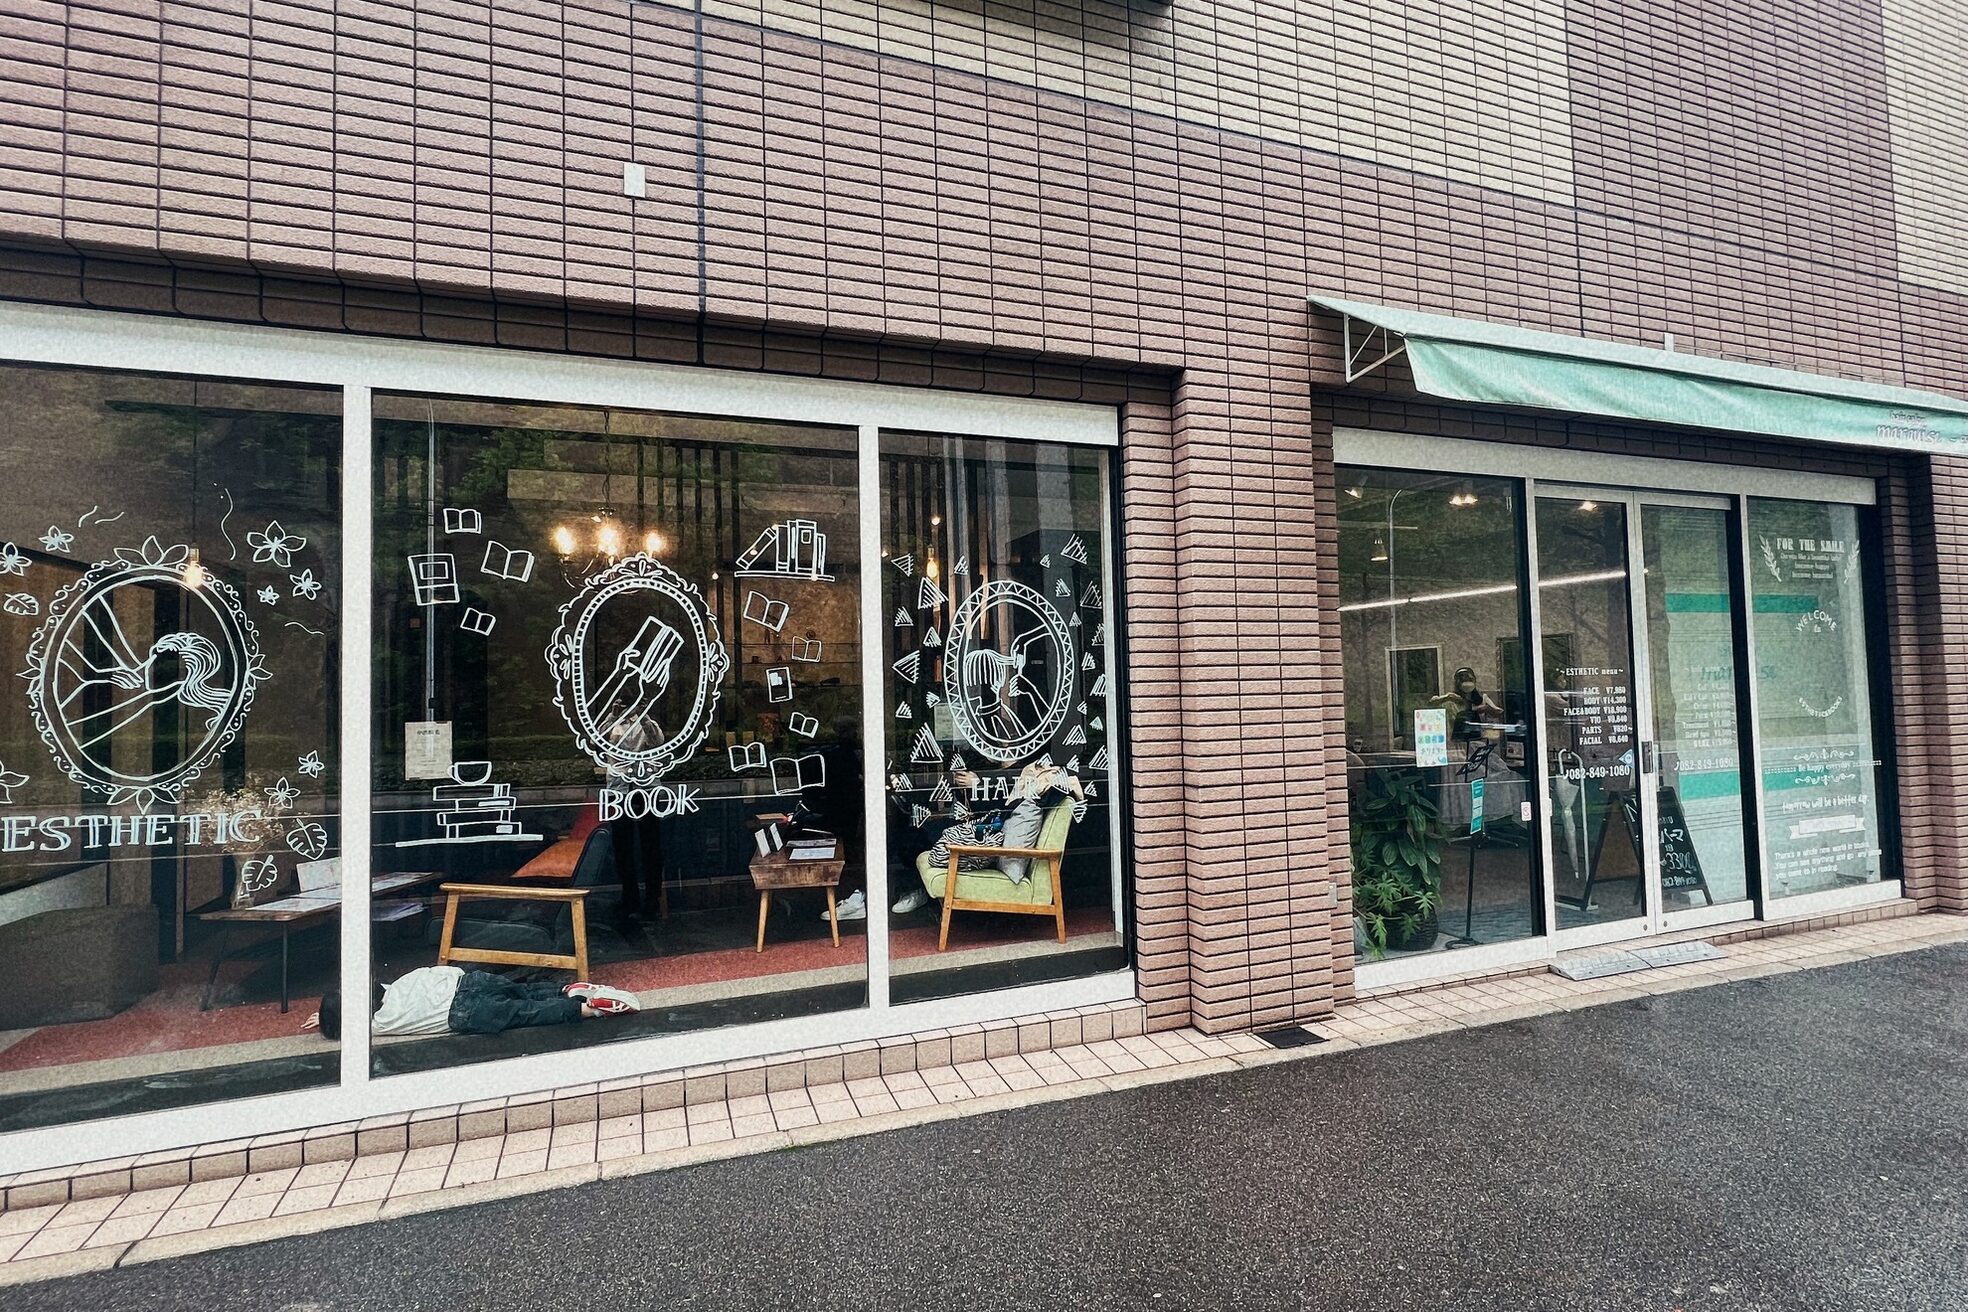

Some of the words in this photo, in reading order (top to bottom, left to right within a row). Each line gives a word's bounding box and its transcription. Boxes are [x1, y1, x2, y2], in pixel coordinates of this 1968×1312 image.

[1777, 538, 1794, 551] FOR
[1799, 539, 1816, 552] THE
[1820, 540, 1845, 553] SMILE
[1795, 610, 1837, 632] WELCOME
[1583, 687, 1600, 695] FACE
[1583, 697, 1600, 705] BODY
[1581, 726, 1602, 735] PARTS
[1579, 737, 1603, 746] FACIAL
[1680, 757, 1734, 771] 082-849-1080
[1569, 764, 1631, 780] 082-849-1080
[971, 774, 1042, 801] HAIR
[598, 784, 700, 822] BOOK
[2, 808, 262, 852] ESTHETIC
